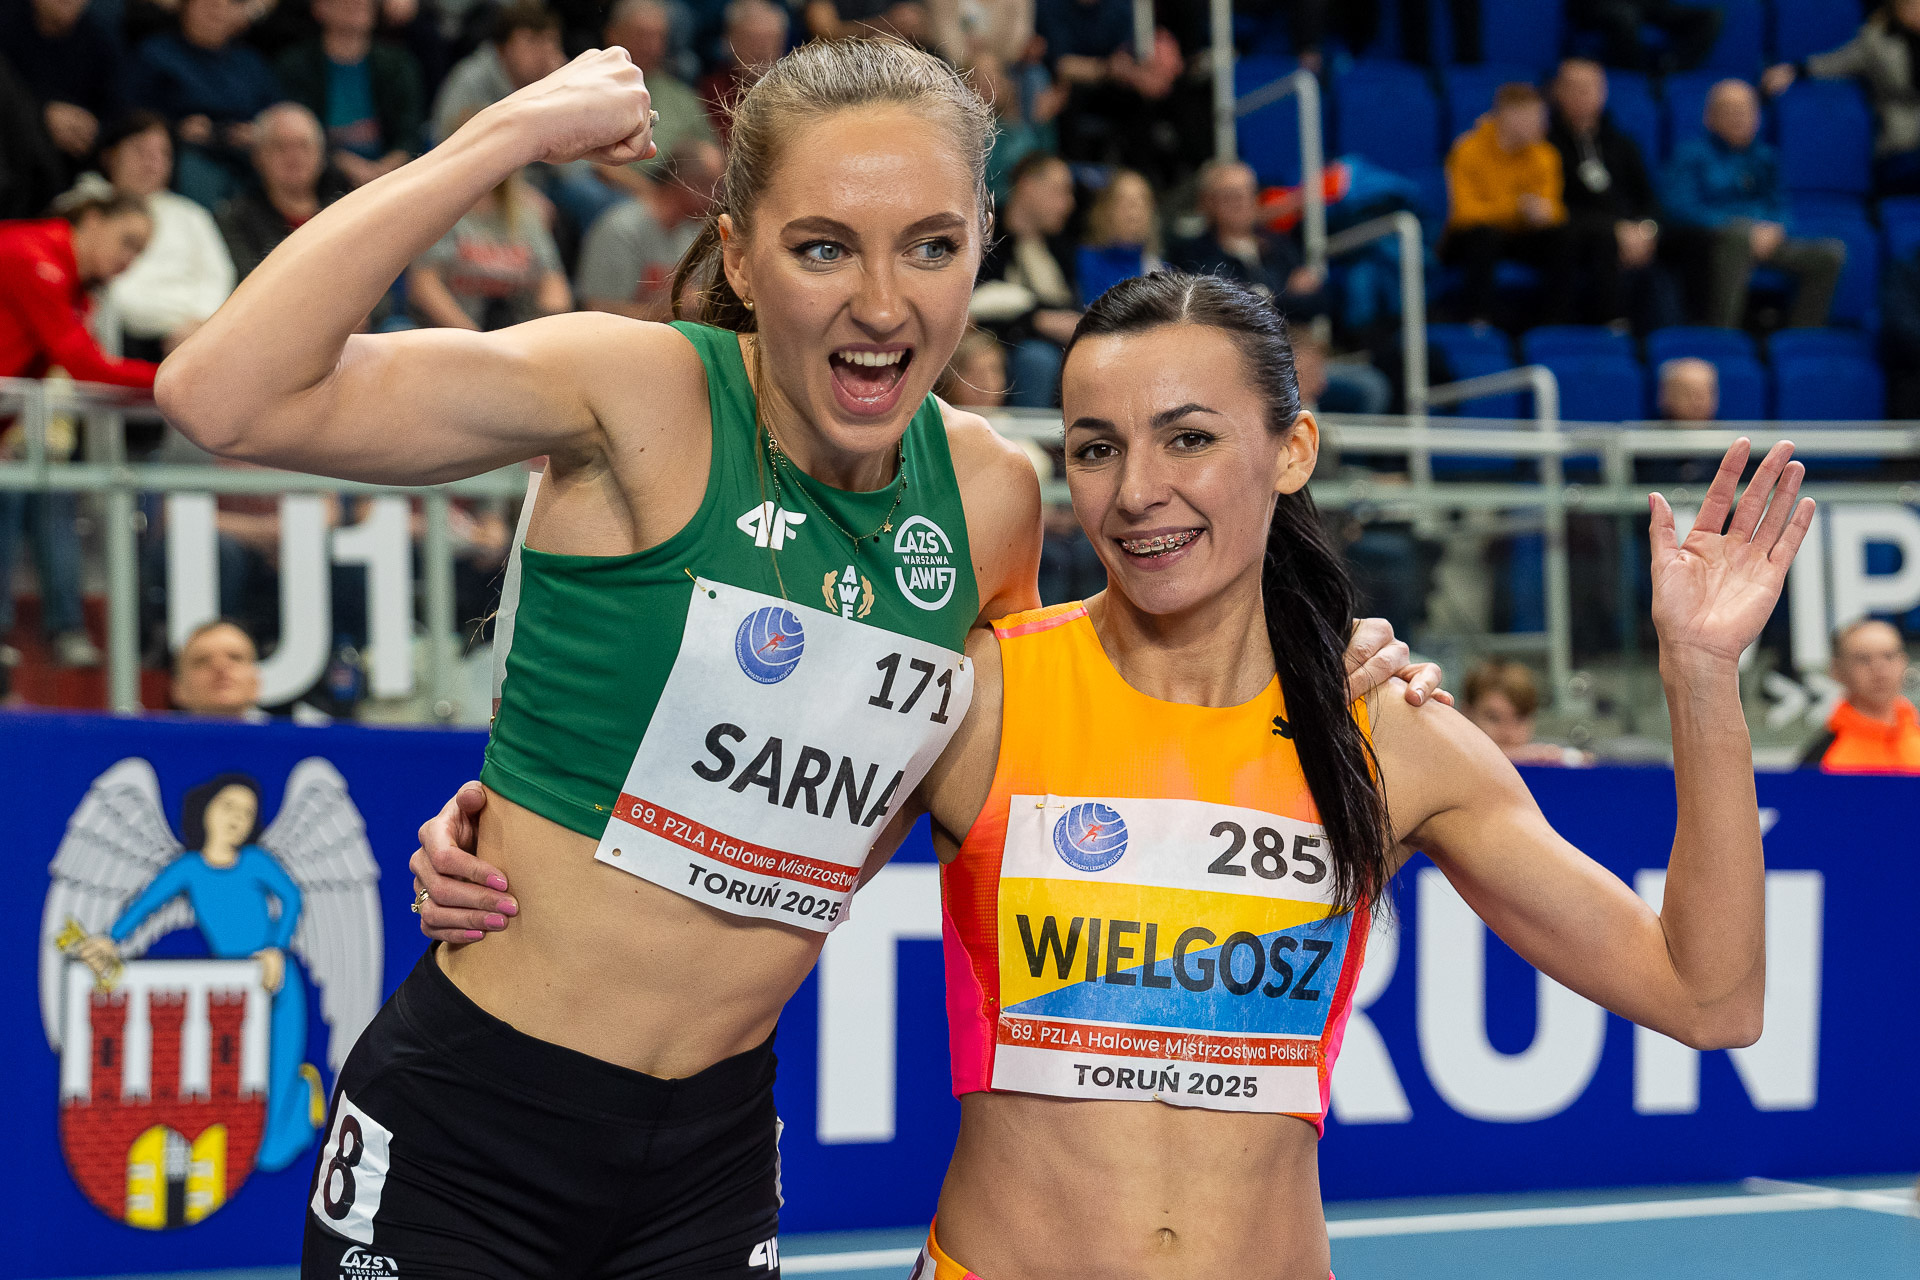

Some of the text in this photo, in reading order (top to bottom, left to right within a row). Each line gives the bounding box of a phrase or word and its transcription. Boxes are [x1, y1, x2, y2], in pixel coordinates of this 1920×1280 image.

[736, 500, 807, 551] 4F
[906, 531, 939, 554] AZS
[902, 555, 949, 565] WARSZAWA
[908, 567, 949, 590] AWF
[868, 652, 953, 724] 171
[631, 803, 658, 827] 69.
[663, 816, 706, 848] PZLA
[710, 837, 776, 871] Halowe
[1207, 821, 1327, 884] 285
[687, 863, 843, 922] TORUŃ 2025
[1016, 914, 1334, 1001] WIELGOSZ
[1011, 1023, 1308, 1061] 69. PZLA Halowe Mistrzostwa Polski
[1074, 1064, 1258, 1098] TORUŃ 2025
[323, 1114, 364, 1220] 8
[345, 1268, 390, 1276] WARSZAWA
[351, 1253, 384, 1269] AZS
